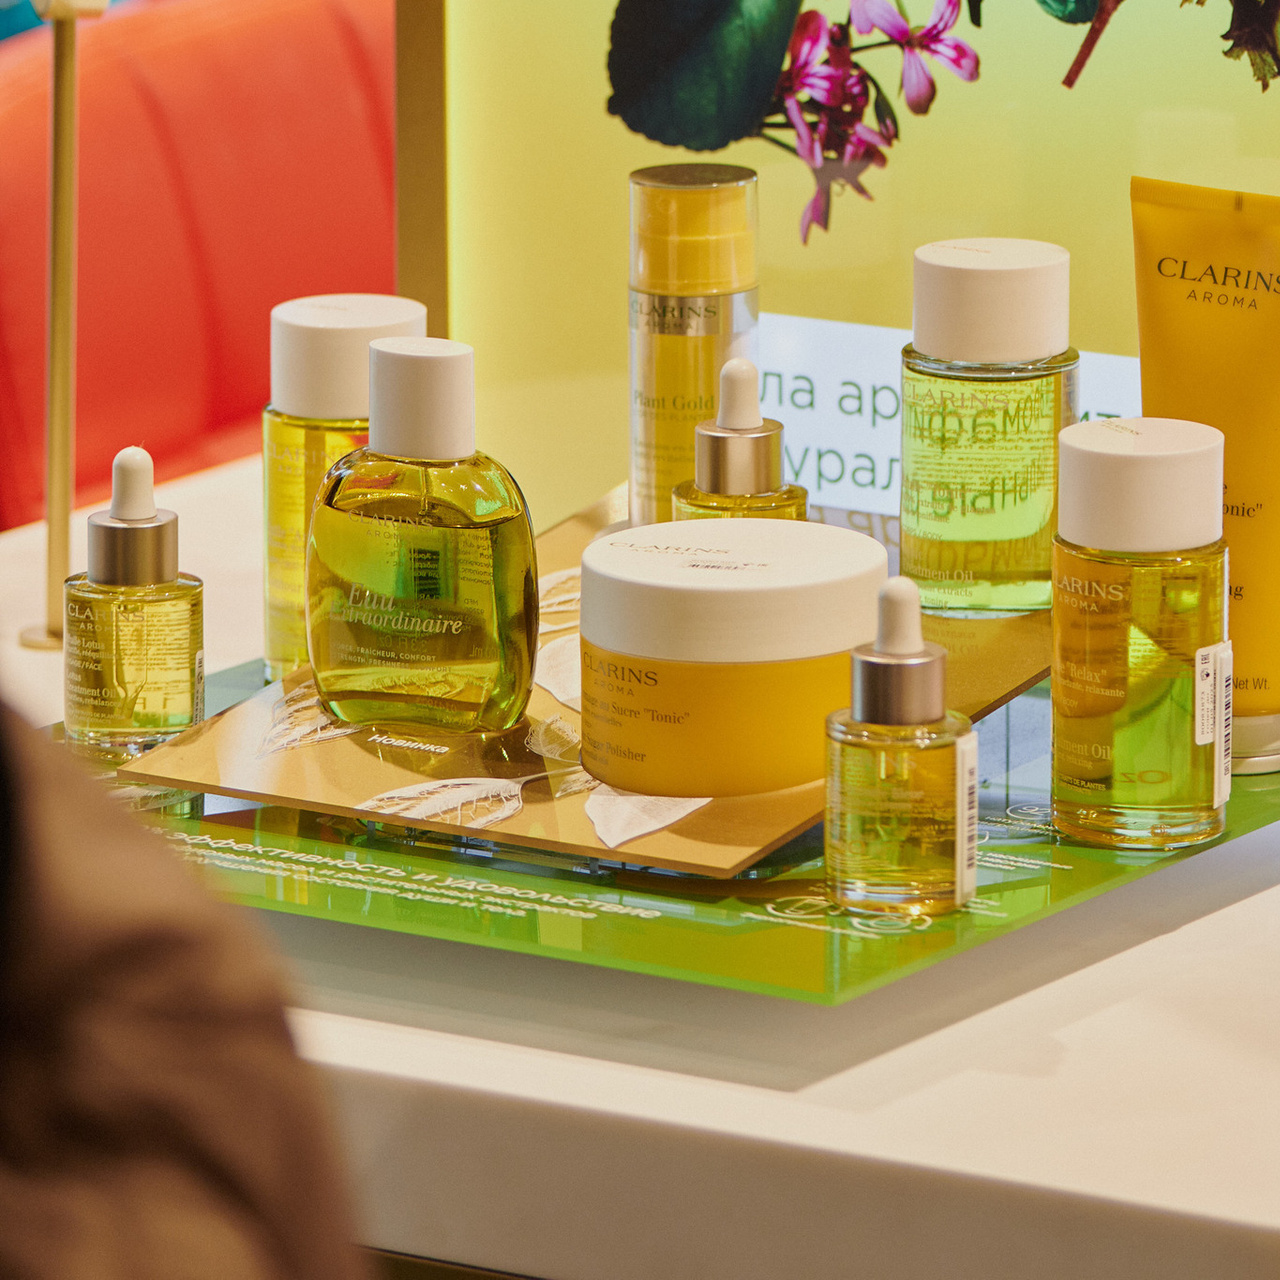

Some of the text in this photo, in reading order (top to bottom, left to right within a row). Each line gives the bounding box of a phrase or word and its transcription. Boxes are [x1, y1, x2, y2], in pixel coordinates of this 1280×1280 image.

[1186, 289, 1259, 311] AROMA
[672, 394, 715, 413] Gold
[347, 509, 434, 532] CLARINS
[954, 569, 975, 585] Oil
[348, 581, 396, 613] Eau
[1054, 574, 1125, 602] LARINS
[67, 602, 146, 623] CLARINS
[1058, 593, 1100, 613] AROMA
[328, 599, 464, 636] Extraordinaire
[399, 652, 437, 663] CONFORT
[583, 651, 659, 687] CLARINS
[1085, 683, 1126, 699] relaxante
[611, 700, 641, 721] Sucre
[643, 707, 691, 726] "Tonic"
[366, 733, 451, 755] Новинка
[605, 742, 648, 763] Polisher
[1091, 742, 1112, 761] Oil
